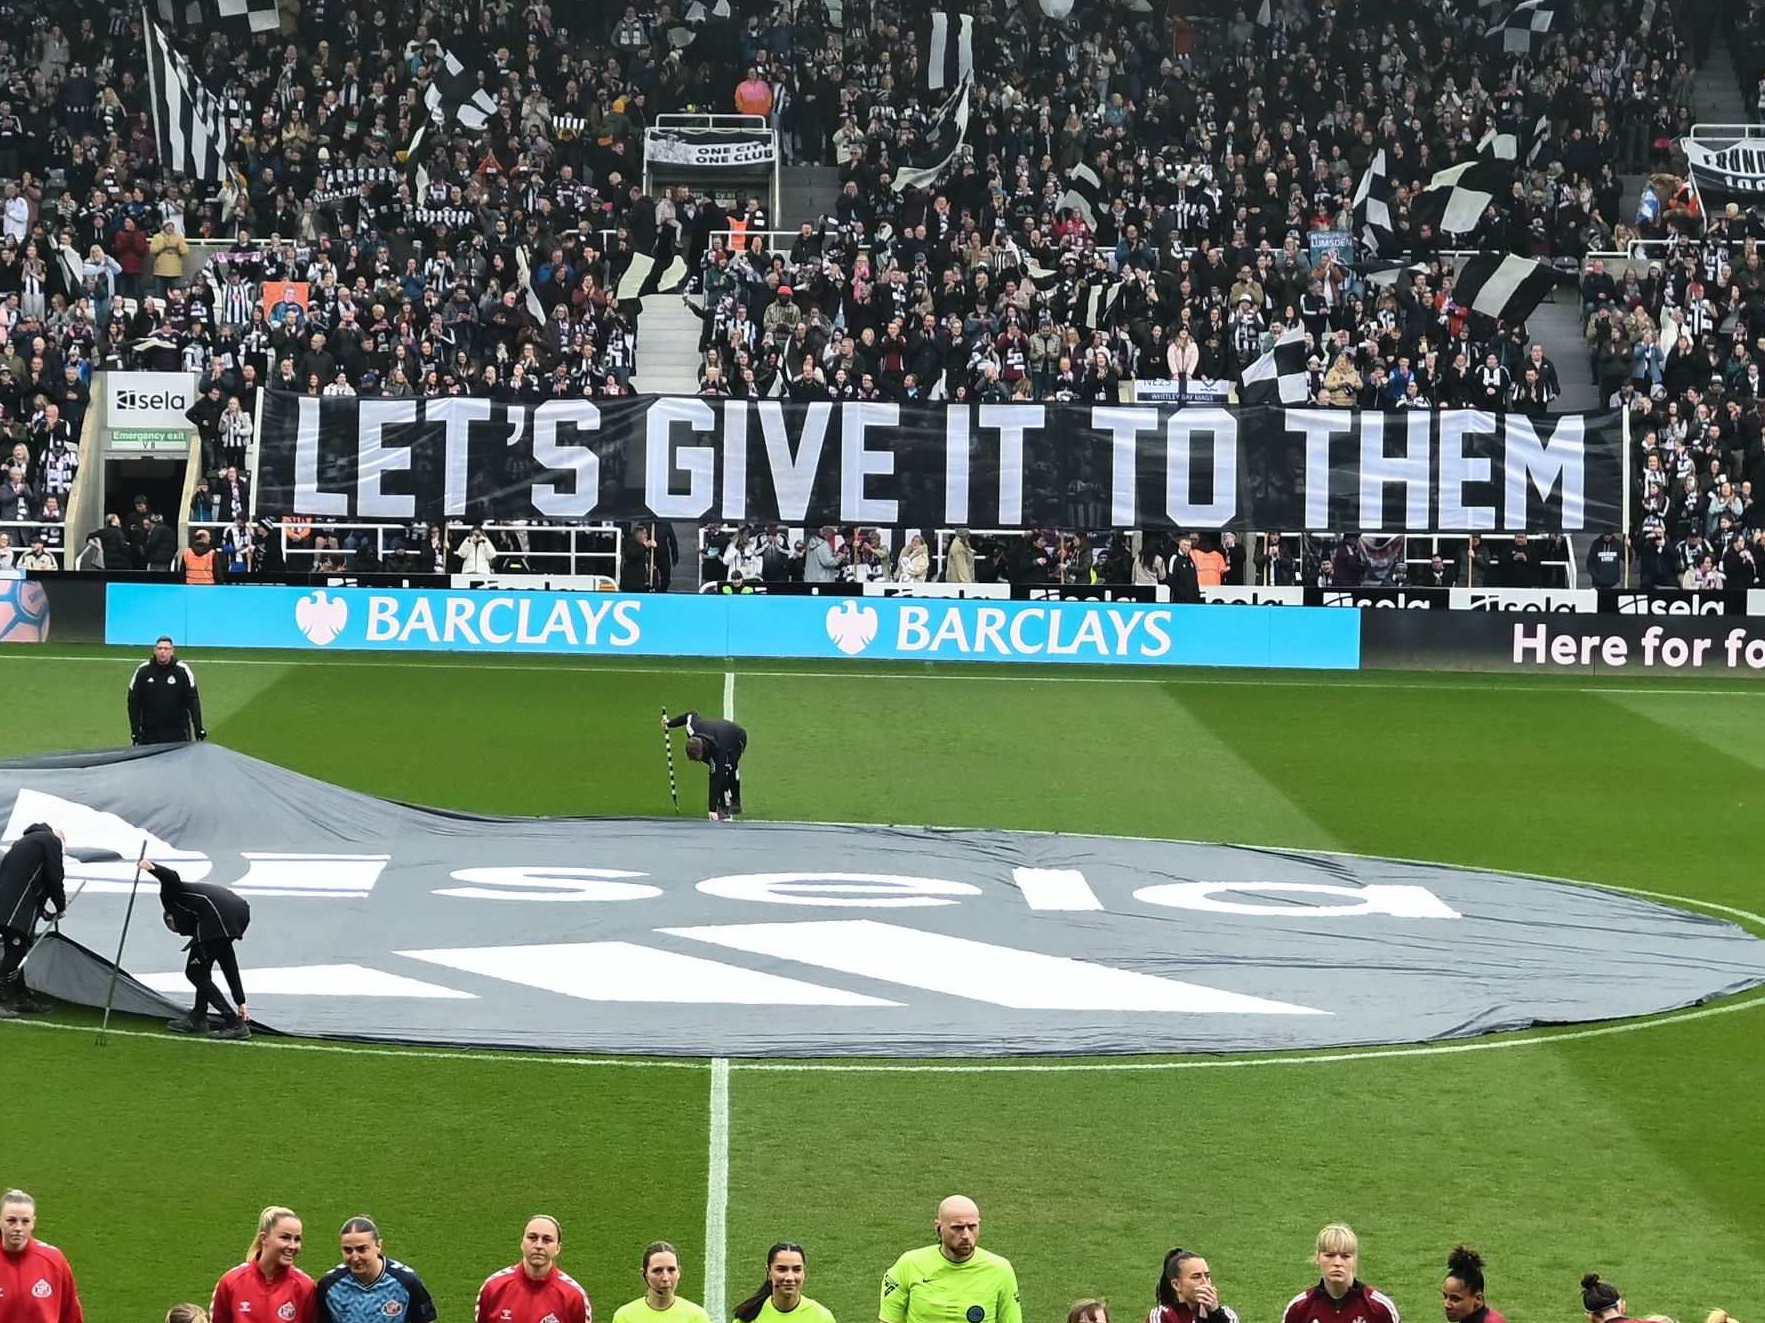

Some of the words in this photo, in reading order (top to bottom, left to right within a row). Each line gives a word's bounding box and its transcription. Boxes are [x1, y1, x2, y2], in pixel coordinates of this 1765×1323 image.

[695, 156, 729, 164] ONE
[734, 149, 773, 162] CLUB
[697, 147, 731, 155] ONE
[138, 391, 185, 411] sela
[113, 432, 165, 441] Emergency
[167, 432, 184, 440] exit
[292, 396, 601, 518] LET'S
[643, 396, 901, 522] GIVE
[943, 404, 1046, 526] IT
[1091, 407, 1238, 528] TO
[1283, 408, 1586, 530] THEM
[1651, 594, 1724, 616] sela
[366, 596, 641, 647] BARCLAYS
[896, 609, 1173, 658] BARCLAYS
[1513, 624, 1627, 666] Here
[1642, 626, 1712, 667] for
[433, 863, 1463, 919] sela
